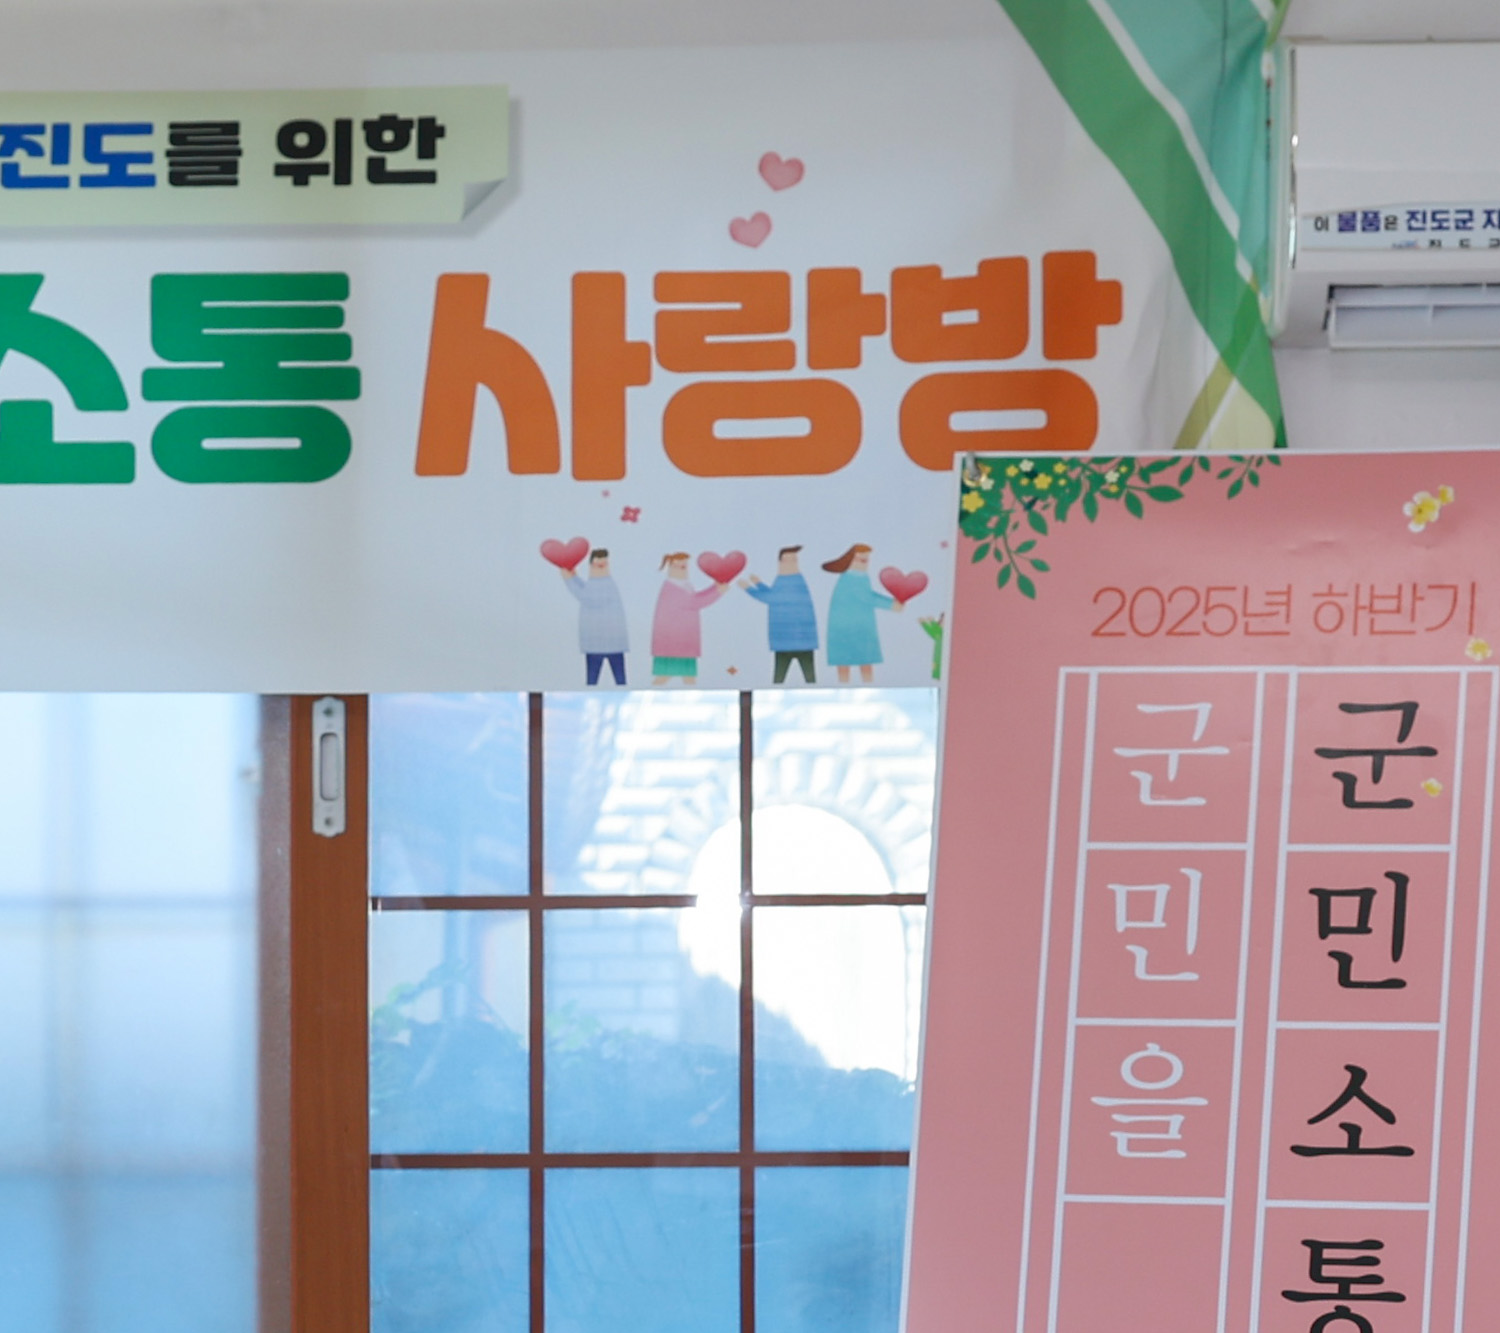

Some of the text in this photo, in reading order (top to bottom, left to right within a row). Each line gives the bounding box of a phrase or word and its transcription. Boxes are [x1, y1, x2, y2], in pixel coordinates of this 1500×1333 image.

[273, 114, 445, 188] 위한
[1314, 215, 1330, 232] 이
[1338, 211, 1398, 233] 물품은
[1406, 208, 1475, 232] 진도군
[414, 250, 1124, 480] 사랑방
[1091, 580, 1478, 639] 2025년 하반기
[1090, 700, 1232, 1159] 군민을
